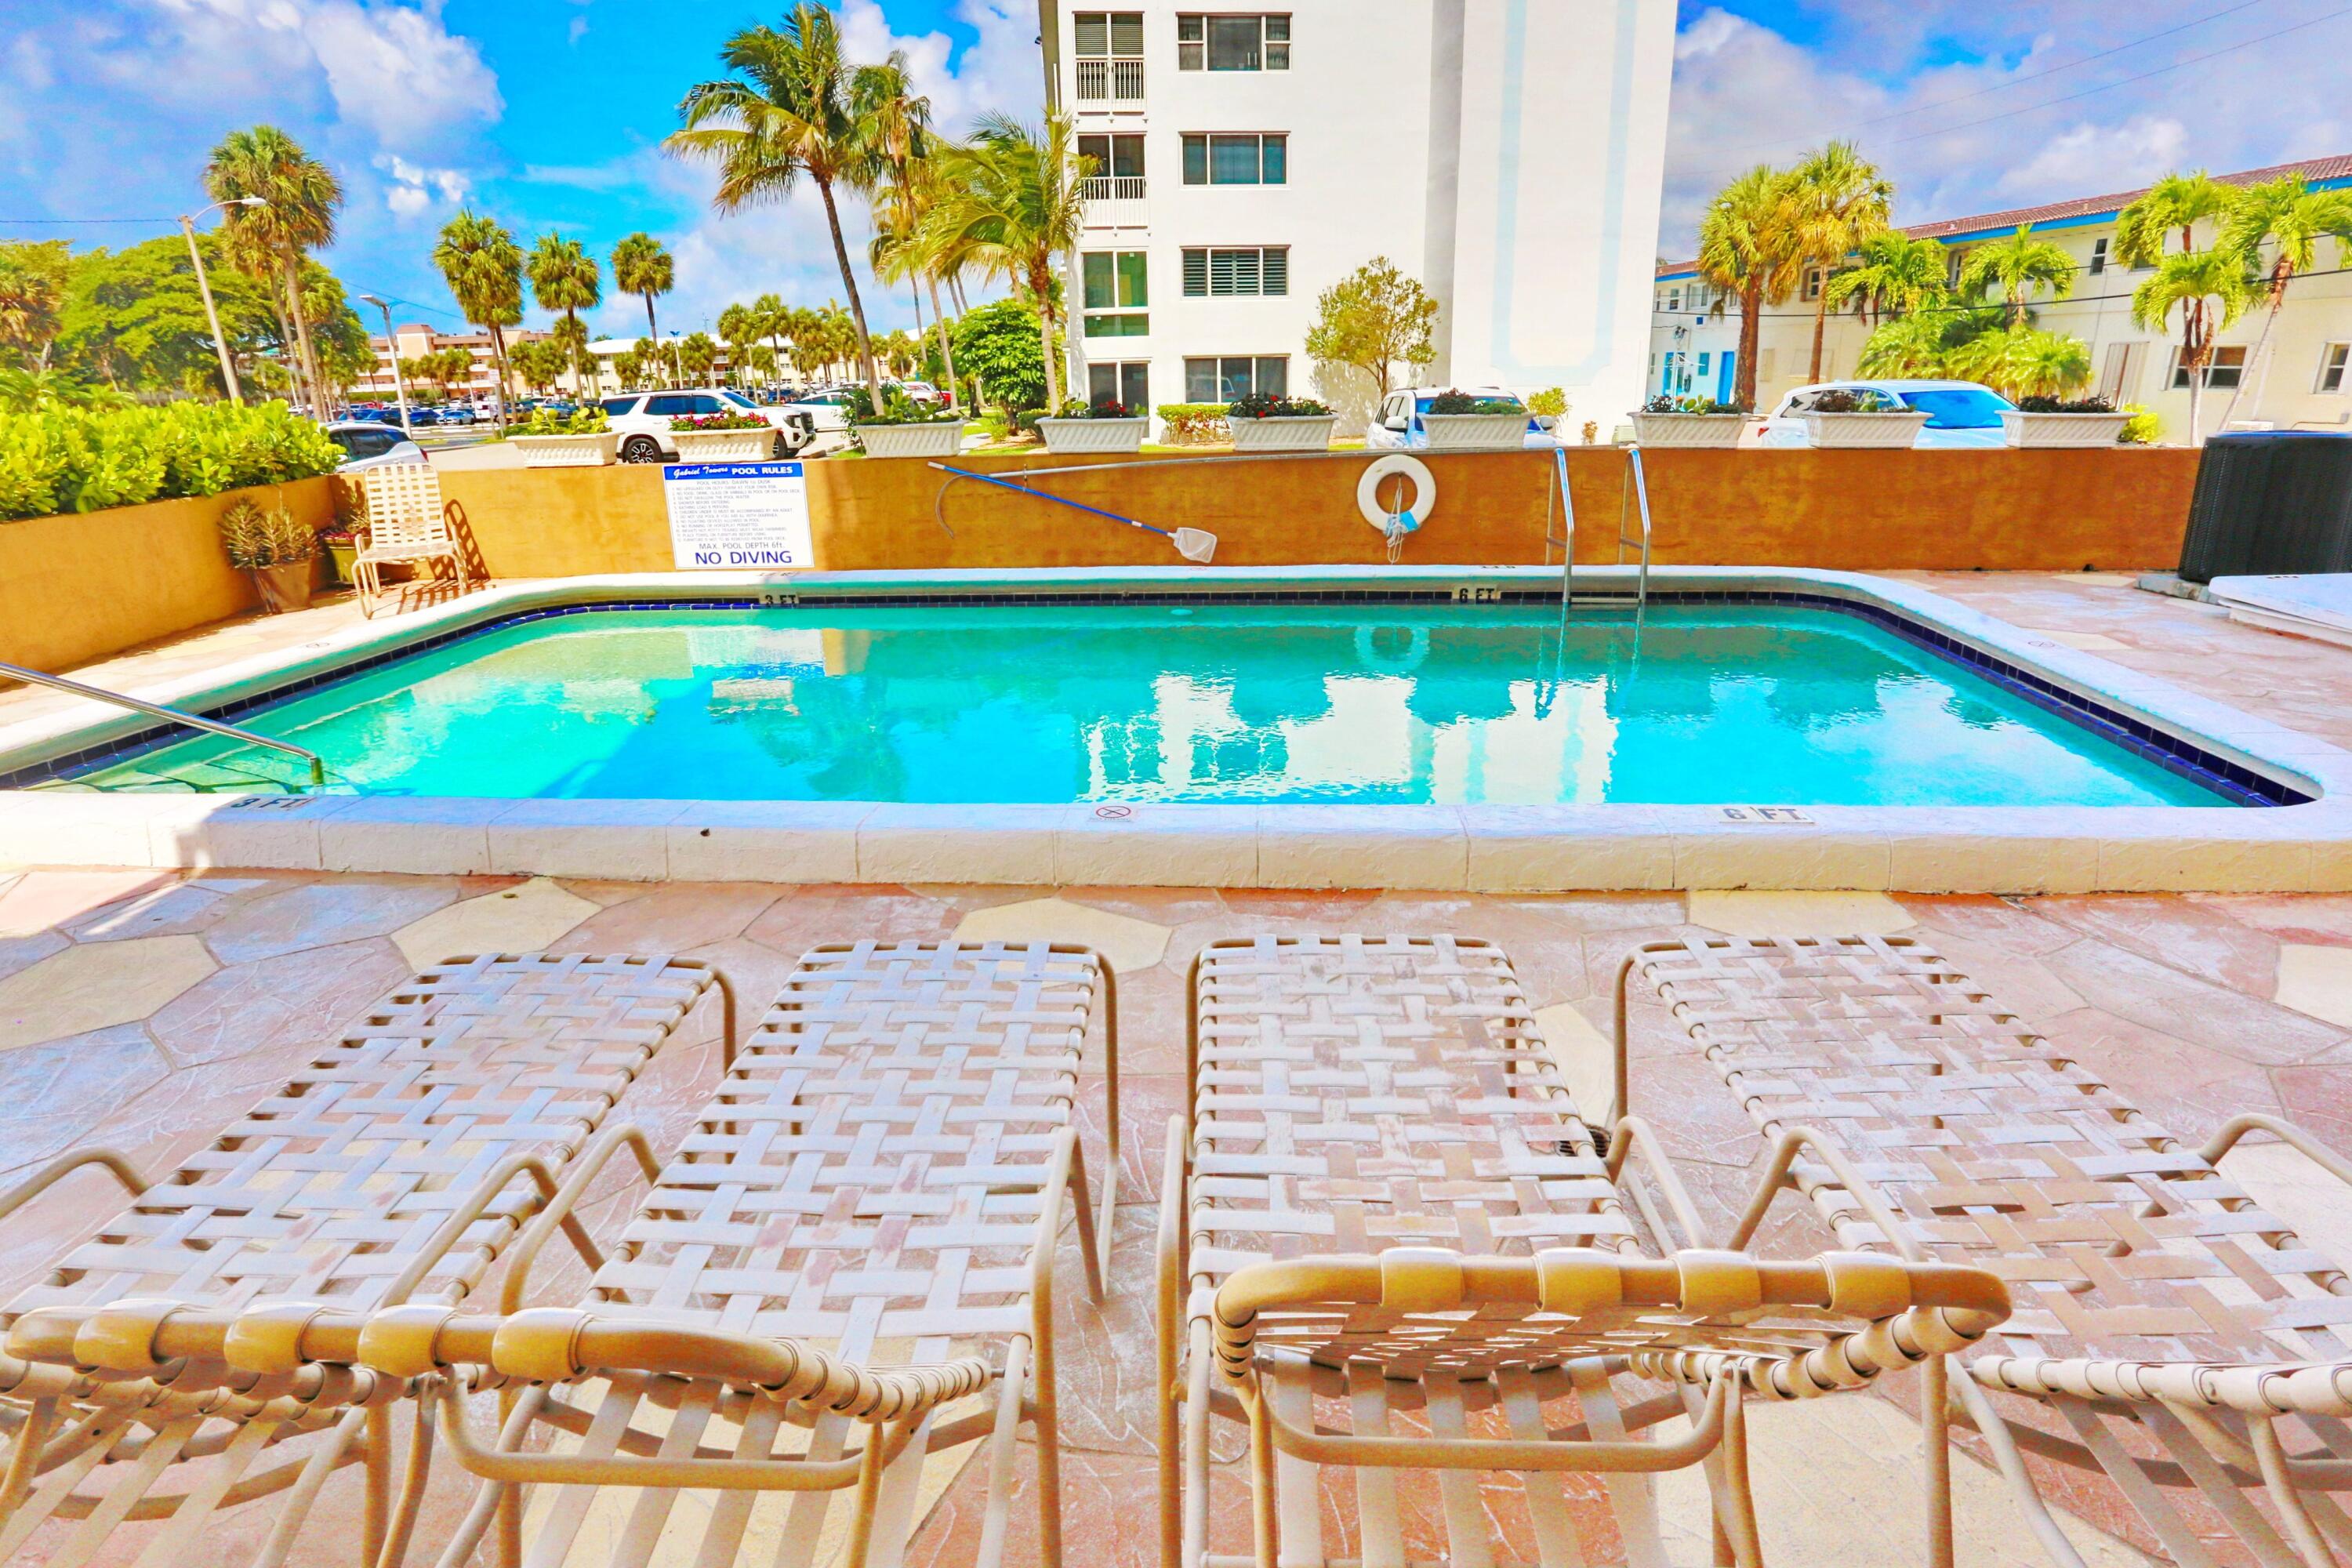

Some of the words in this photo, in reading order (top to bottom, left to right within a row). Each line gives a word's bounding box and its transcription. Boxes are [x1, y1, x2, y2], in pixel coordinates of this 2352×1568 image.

[673, 468, 699, 479] Gabriel
[695, 552, 721, 564] NO
[731, 551, 792, 564] DIVING
[765, 594, 774, 606] 3
[1459, 588, 1468, 603] 6
[230, 797, 261, 808] 3
[1722, 808, 1748, 820] 6
